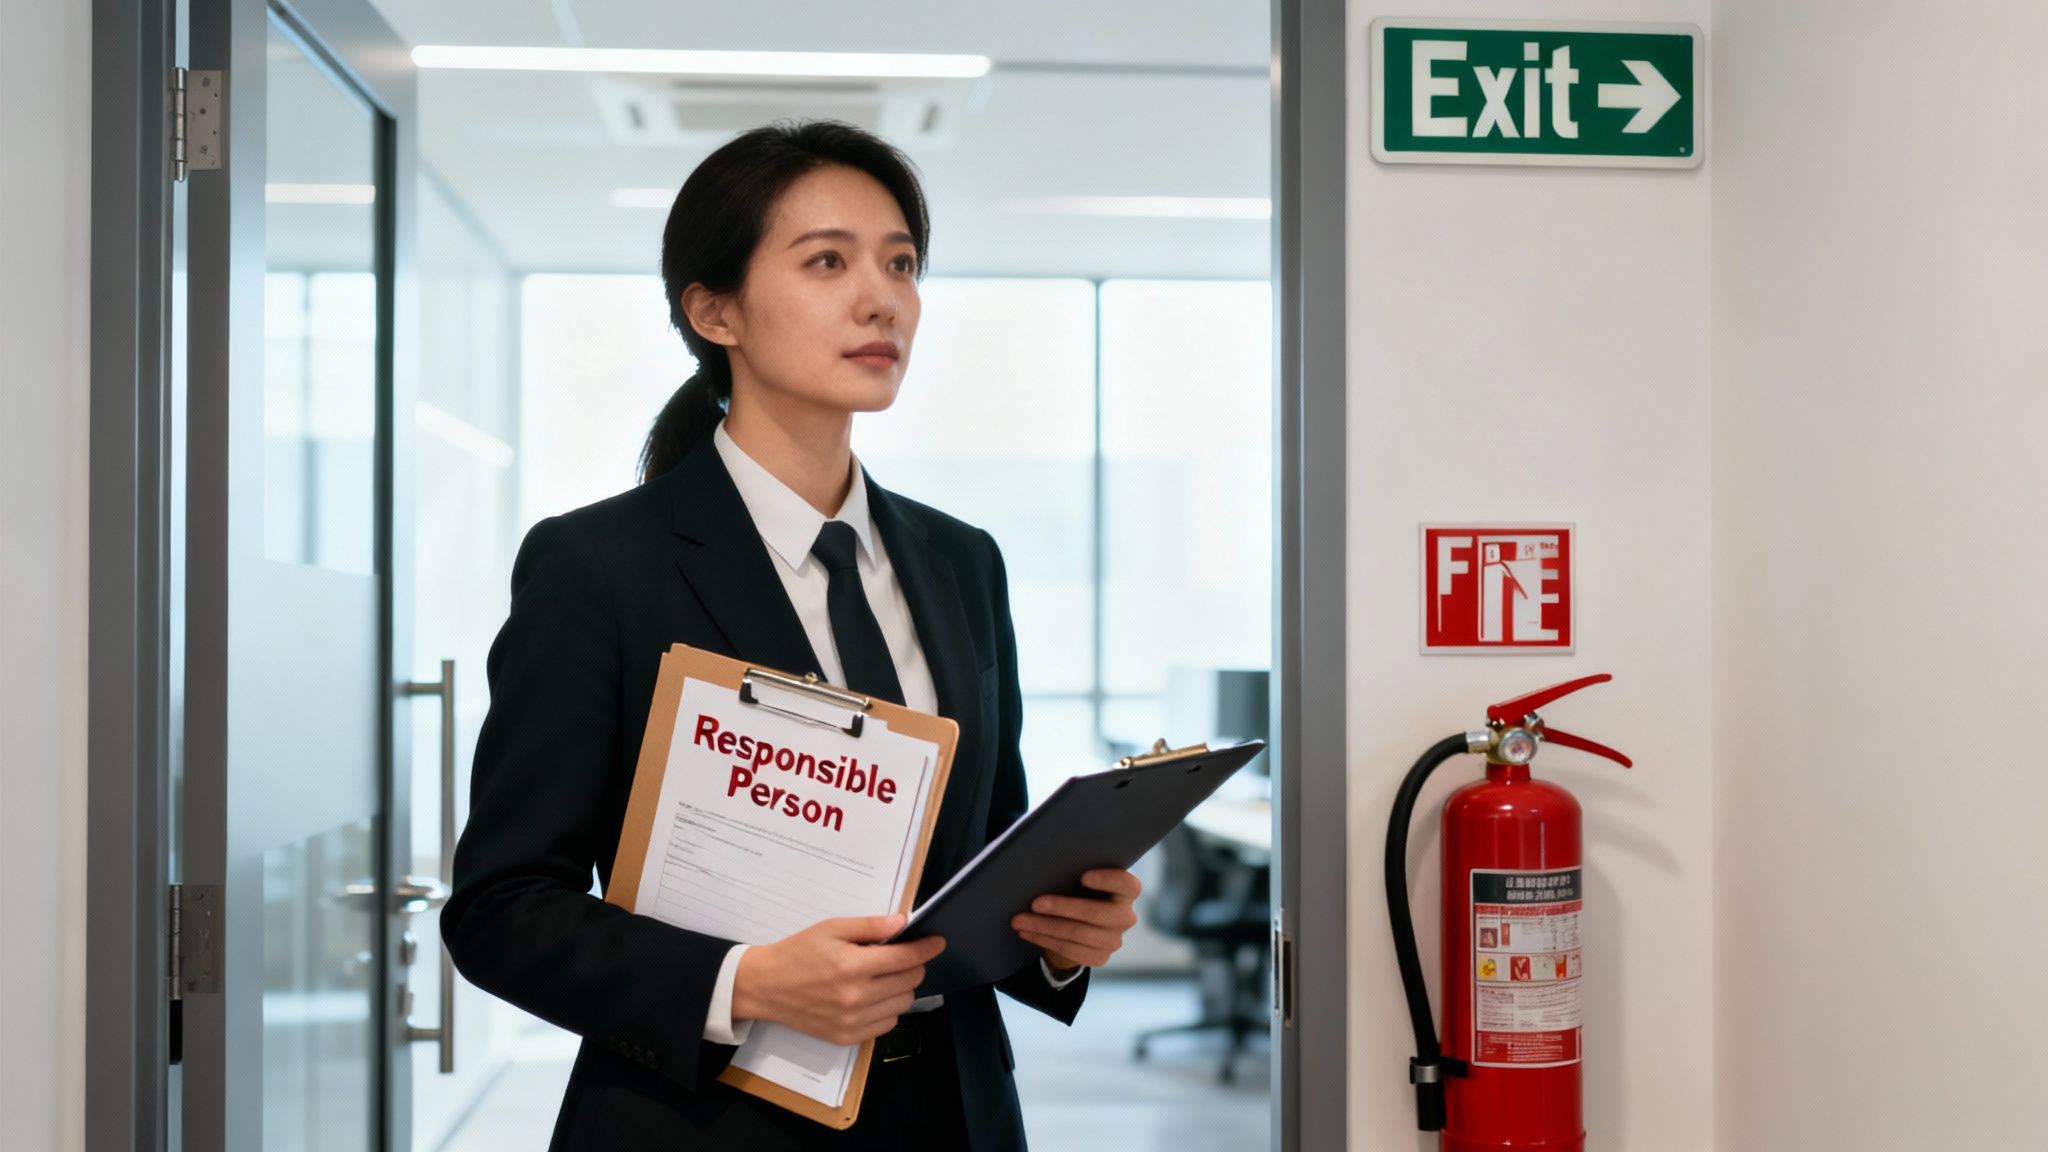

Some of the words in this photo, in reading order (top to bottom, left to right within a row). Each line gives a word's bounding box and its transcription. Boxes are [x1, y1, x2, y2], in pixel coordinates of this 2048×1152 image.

[1411, 39, 1580, 139] Exit
[693, 713, 897, 805] Responsible
[726, 764, 845, 832] Person
